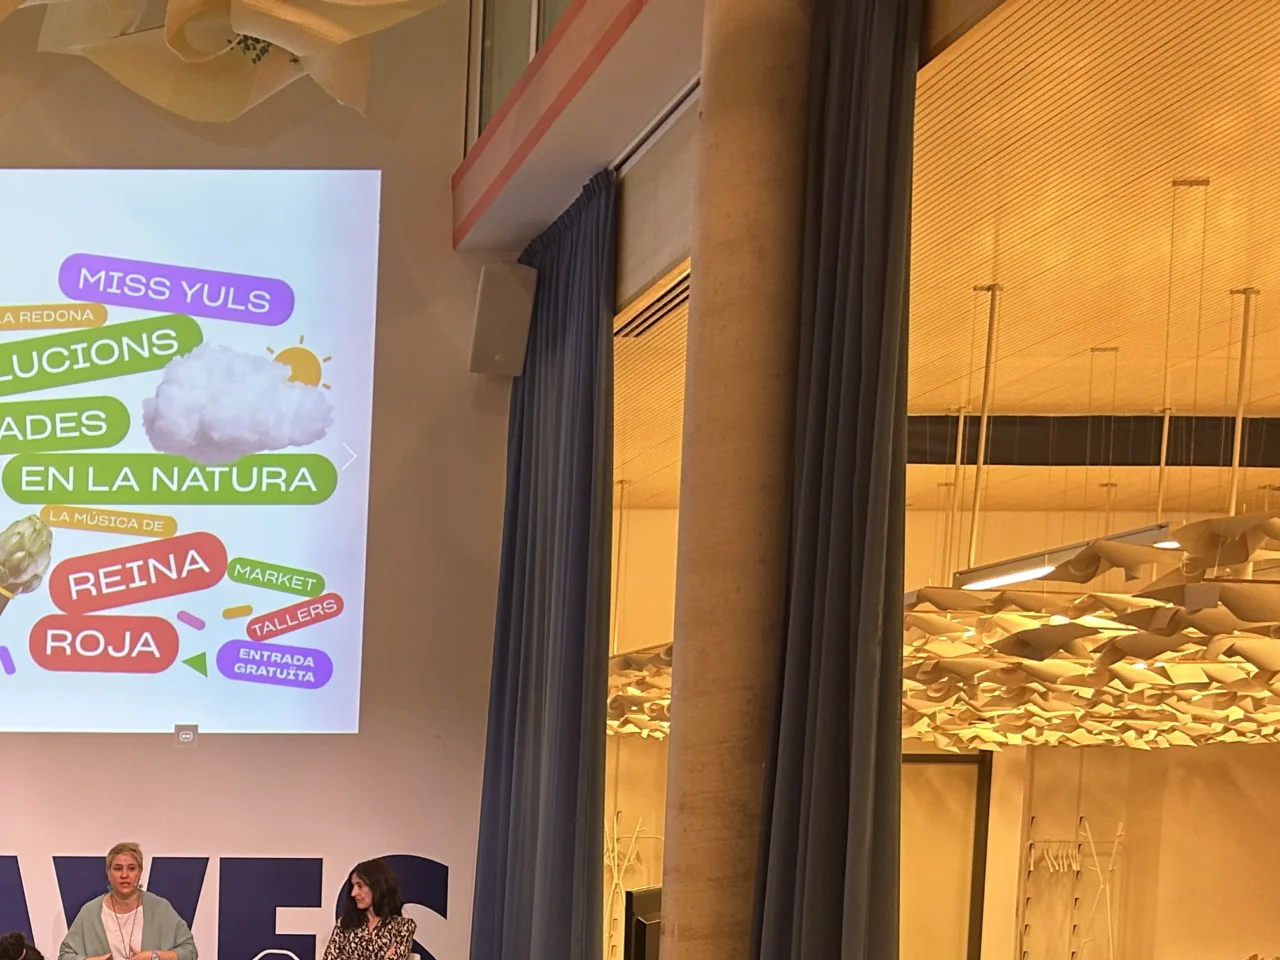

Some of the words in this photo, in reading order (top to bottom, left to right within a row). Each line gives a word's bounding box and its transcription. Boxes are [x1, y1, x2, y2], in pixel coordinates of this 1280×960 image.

[78, 267, 172, 300] MISS
[180, 281, 272, 314] YULS
[19, 308, 95, 323] REDONA
[20, 466, 76, 493] EN
[87, 467, 140, 493] LA
[151, 466, 319, 493] NATURA
[49, 510, 71, 522] LA
[74, 510, 139, 529] MÚSICA
[141, 518, 164, 531] DE
[67, 549, 211, 601] REINA
[233, 564, 317, 591] MARKET
[251, 599, 338, 637] TALLERS
[45, 629, 161, 659] ROJA
[238, 648, 315, 668] ENTRADA
[233, 662, 316, 683] GRATUÏTA
